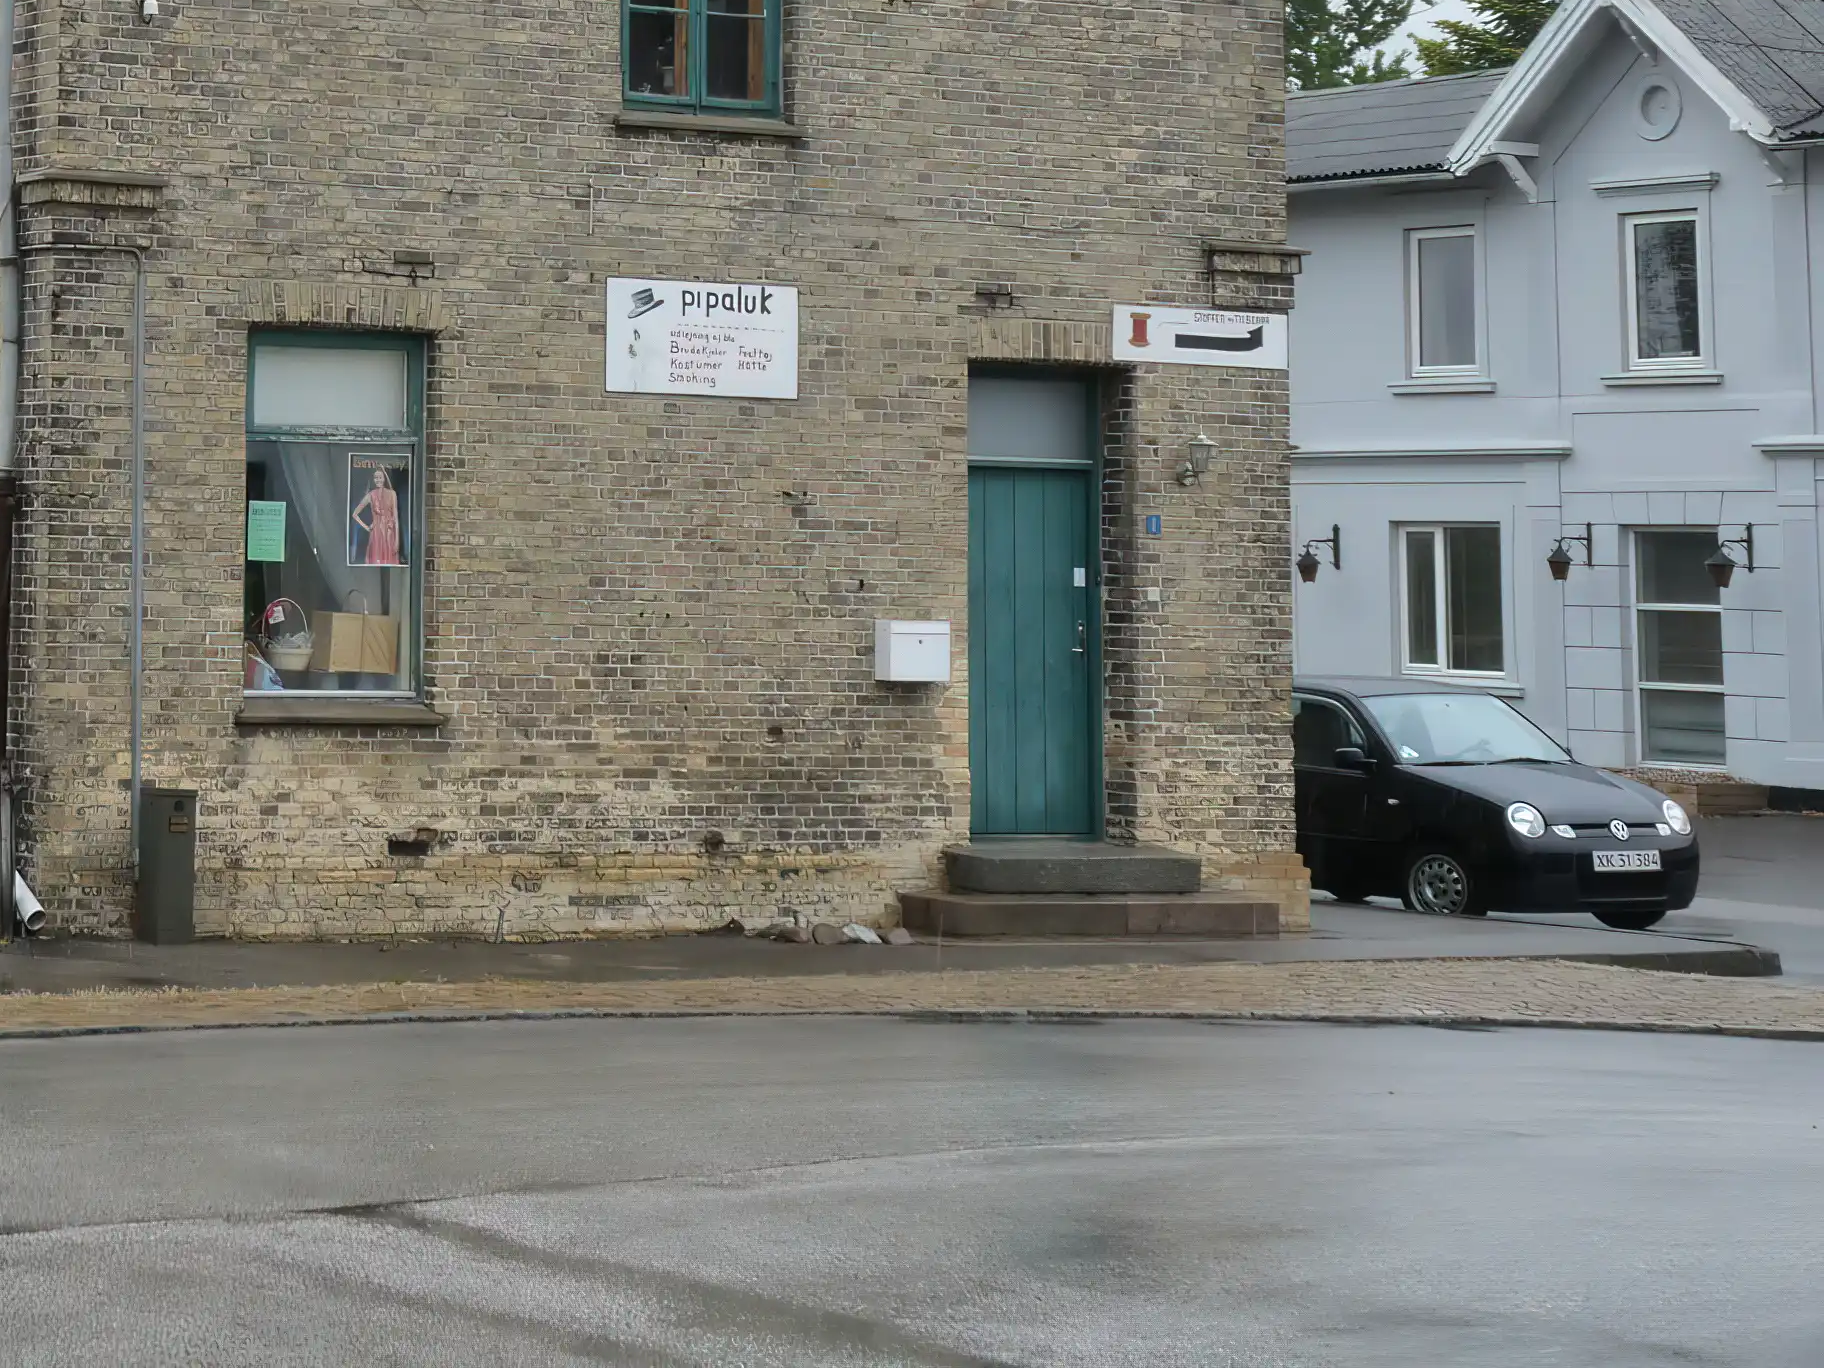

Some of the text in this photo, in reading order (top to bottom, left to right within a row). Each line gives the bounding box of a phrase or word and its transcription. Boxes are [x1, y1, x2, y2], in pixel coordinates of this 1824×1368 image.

[682, 285, 773, 318] pipaluk
[668, 372, 716, 388] Smoking
[1596, 854, 1616, 868] XK
